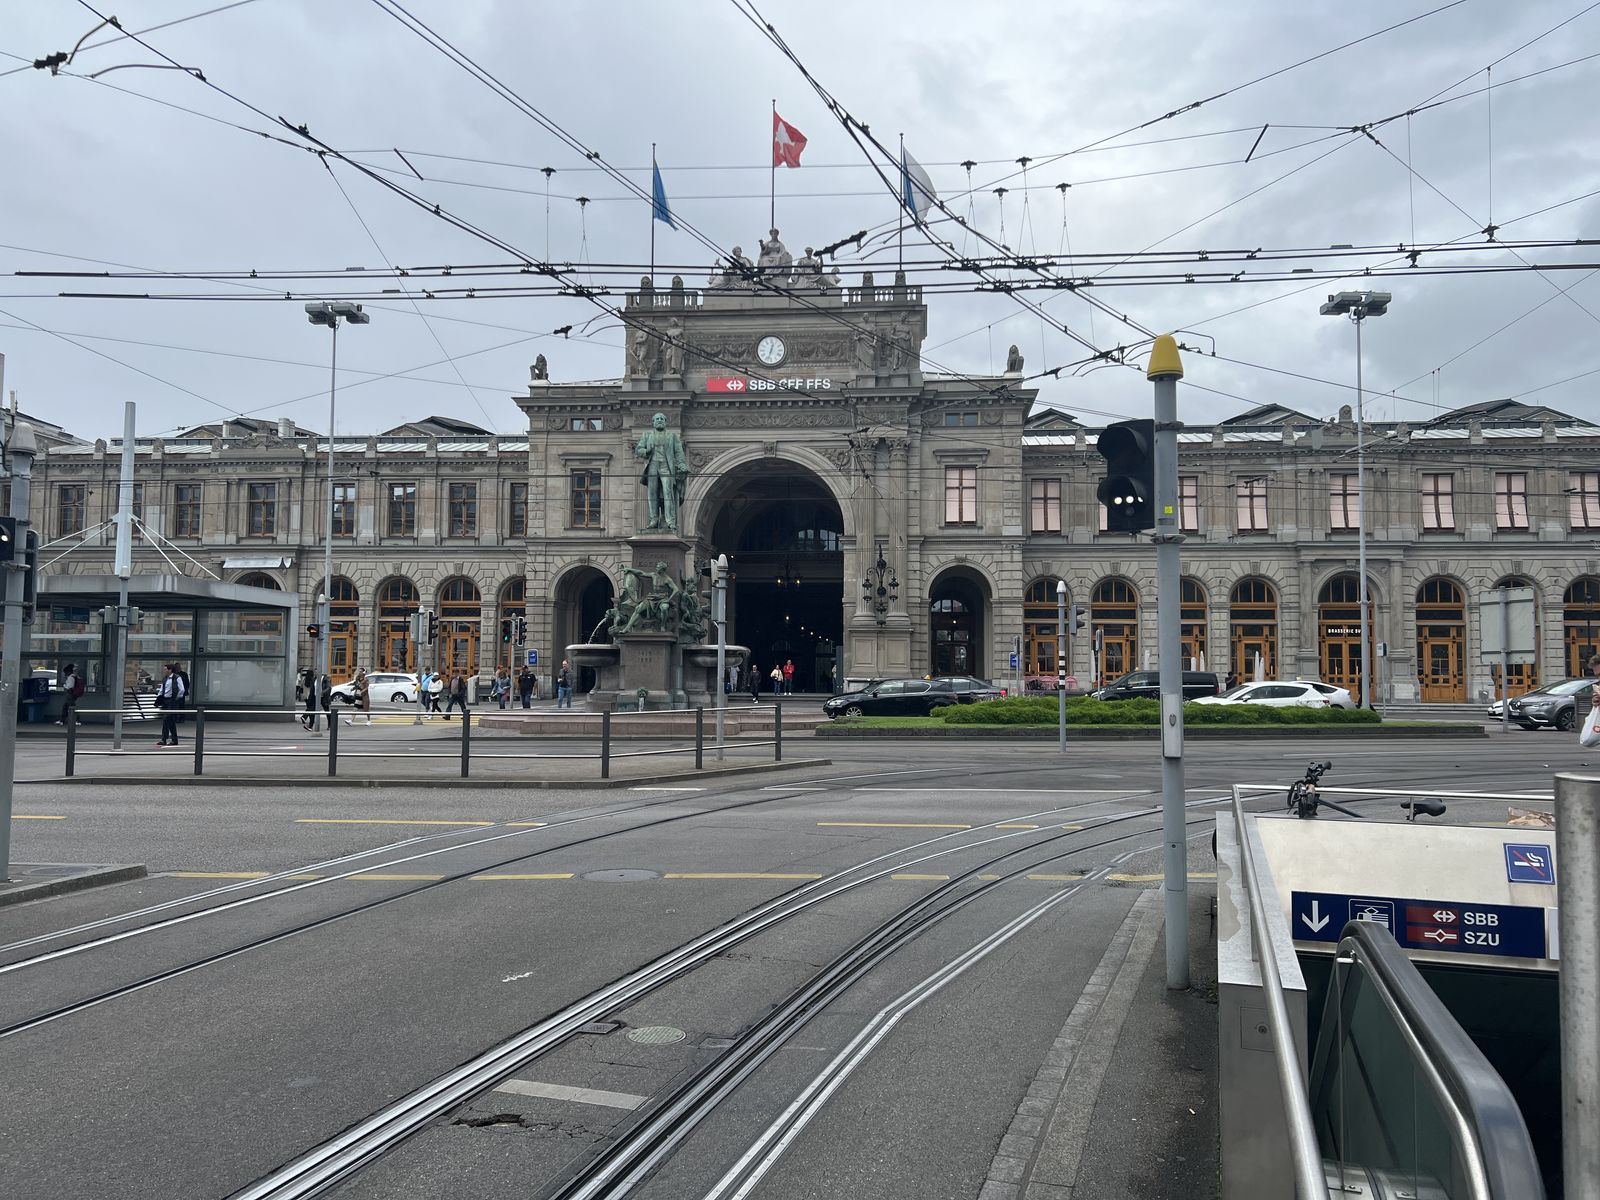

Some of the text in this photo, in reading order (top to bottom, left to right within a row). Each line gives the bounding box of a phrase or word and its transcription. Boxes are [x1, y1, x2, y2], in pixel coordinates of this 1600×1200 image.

[749, 379, 831, 391] SBB CFF FFS
[1463, 911, 1499, 926] SBB
[1463, 931, 1500, 946] SZU
